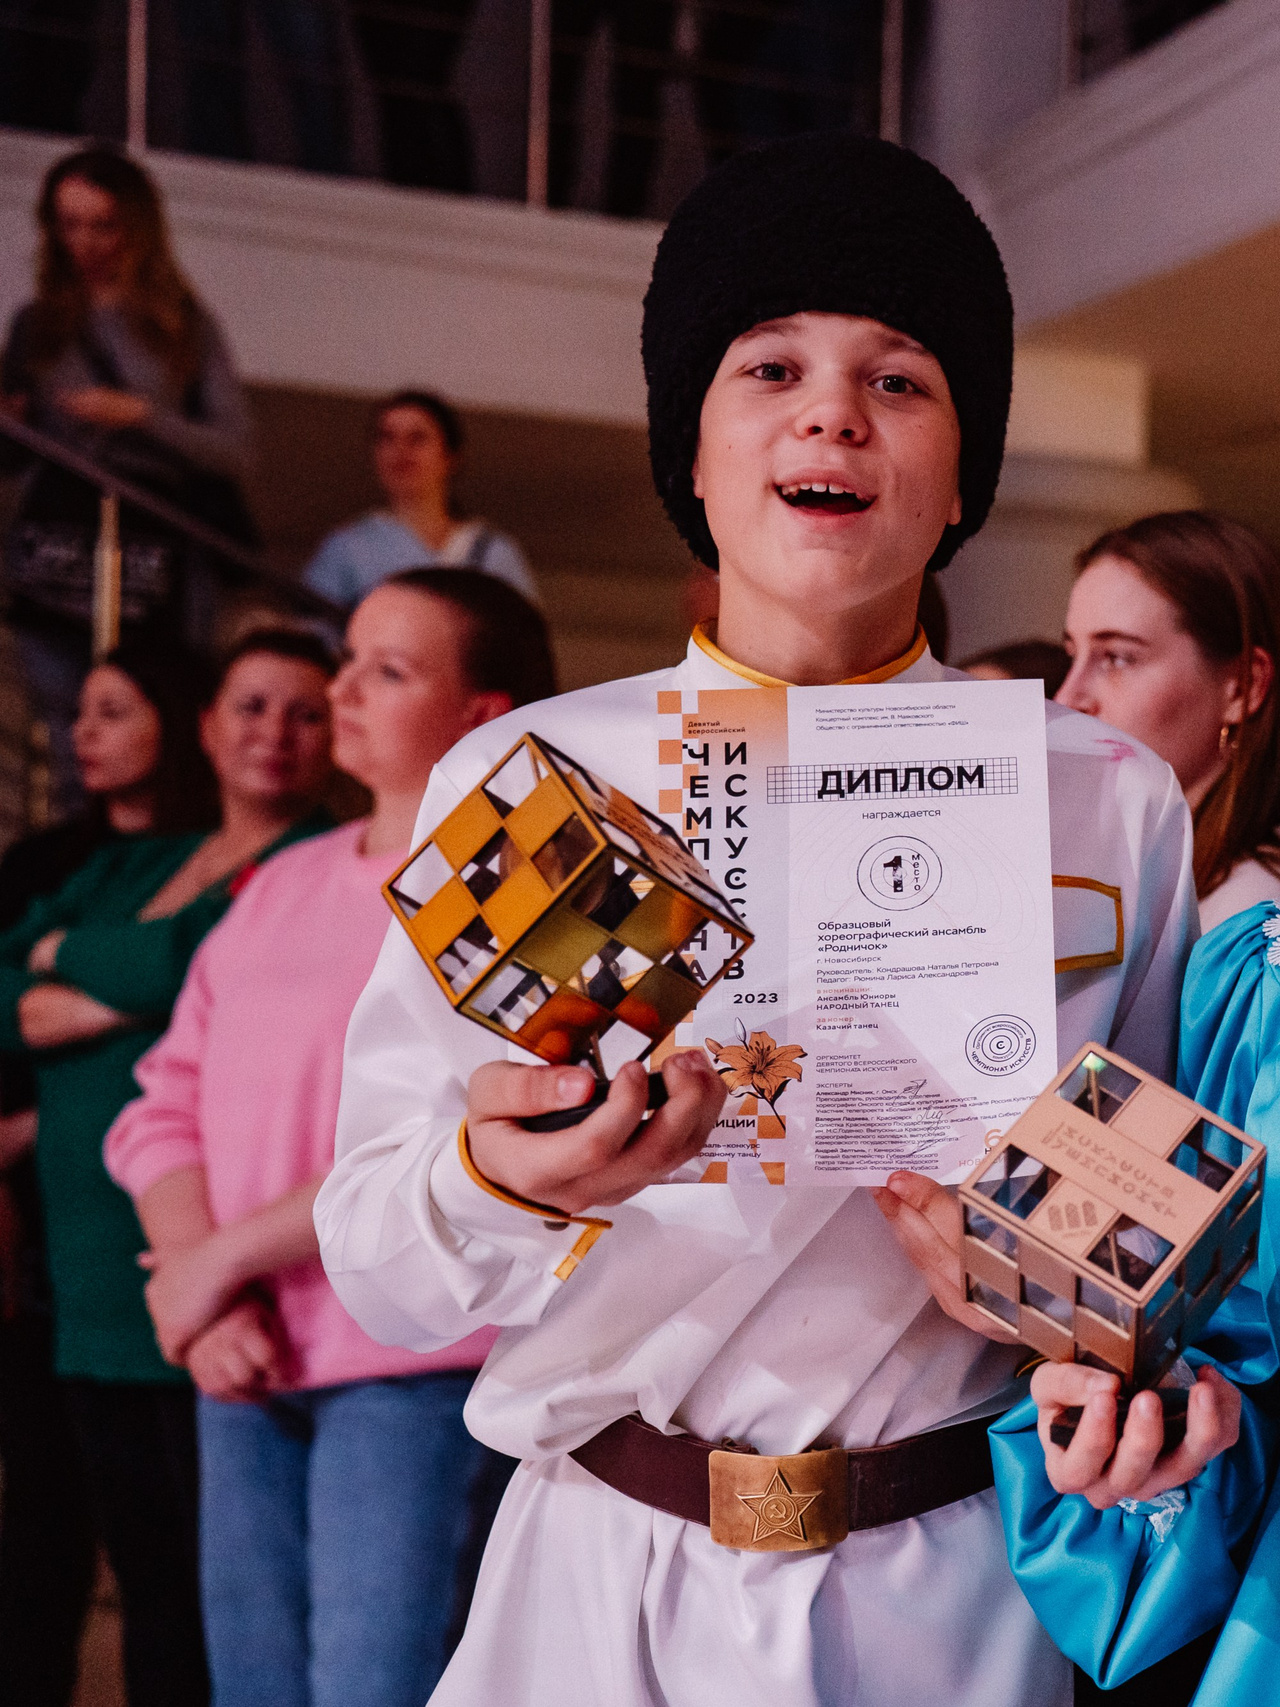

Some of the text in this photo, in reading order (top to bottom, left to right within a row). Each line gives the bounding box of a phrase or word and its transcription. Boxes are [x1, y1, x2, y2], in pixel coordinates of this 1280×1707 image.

[817, 764, 985, 800] ДИПЛОМ
[862, 808, 942, 820] награждается
[883, 853, 922, 893] 1 место
[817, 918, 892, 932] Образцовый
[817, 925, 988, 944] хореографический ансамбль
[817, 942, 888, 953] «Родничок»
[824, 956, 882, 964] Новосибирск
[816, 960, 1000, 977] Руководитель: Кондрашова Наталья Петровна
[816, 976, 852, 984] Педагог:
[917, 970, 979, 980] Александровна
[732, 992, 779, 1004] 2023
[860, 993, 897, 1001] Юниоры
[816, 1001, 900, 1011] НАРОДНЫЙ ТАНЕЦ
[816, 1023, 880, 1031] Казачий танец
[971, 1038, 1032, 1072] ЧЕМПИОНАТ ИСКУССТВ
[853, 1058, 918, 1066] ВСЕРОССИЙСКОГО
[713, 1119, 756, 1129] ИЦИИ
